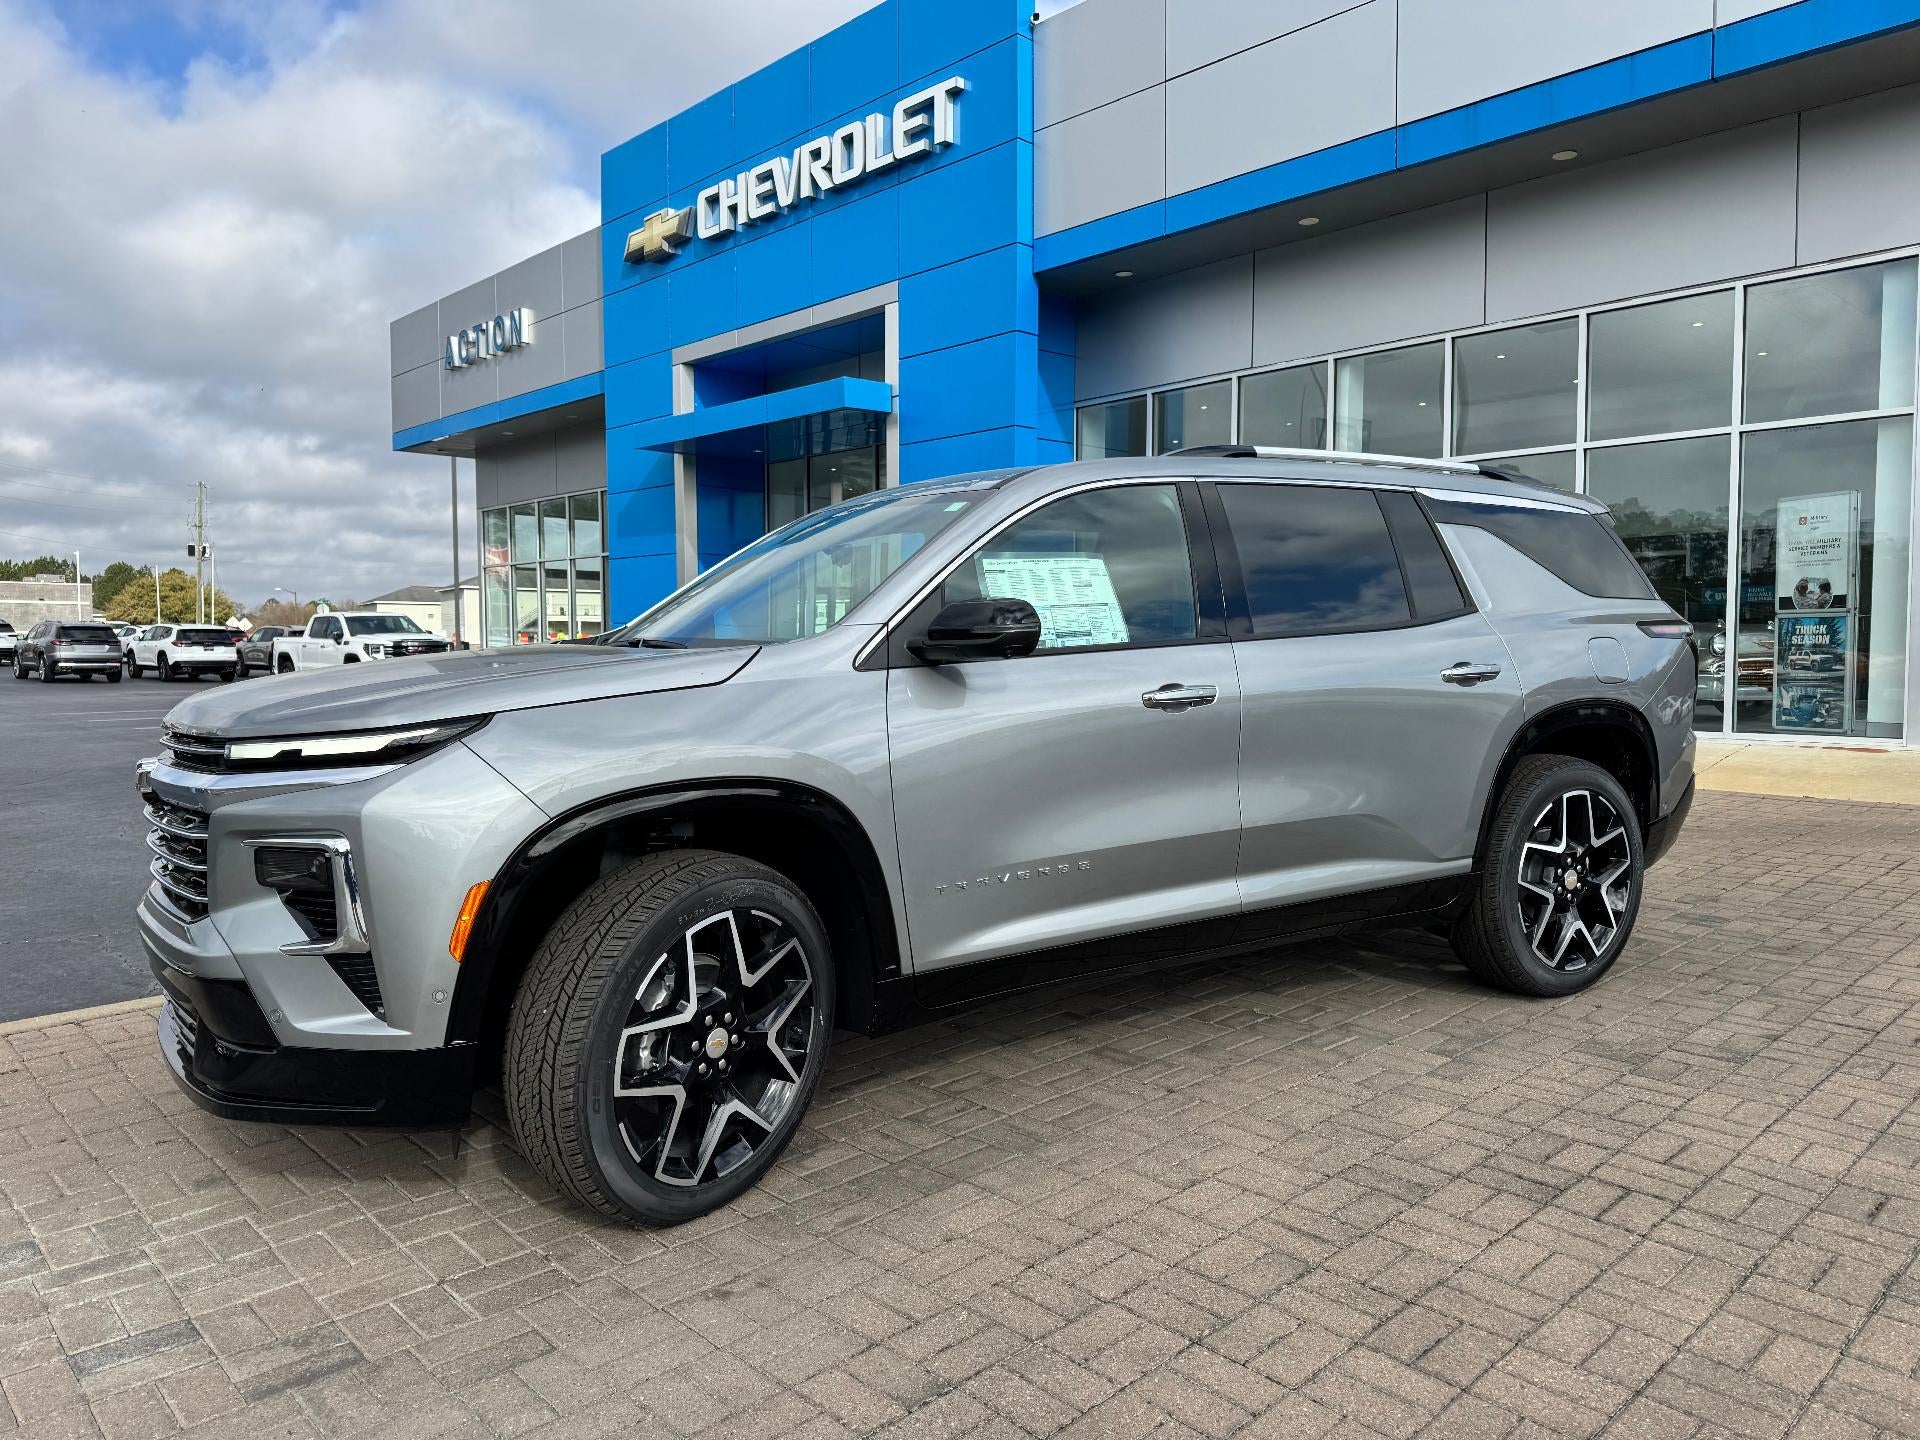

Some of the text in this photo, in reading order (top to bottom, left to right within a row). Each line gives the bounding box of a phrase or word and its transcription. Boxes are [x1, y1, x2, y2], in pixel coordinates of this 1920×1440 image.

[697, 75, 964, 239] CHEVROLET
[444, 307, 530, 370] ACTION
[1791, 634, 1831, 645] SEASON
[1795, 624, 1828, 635] TRUCK
[934, 860, 1091, 895] TRAVERSE
